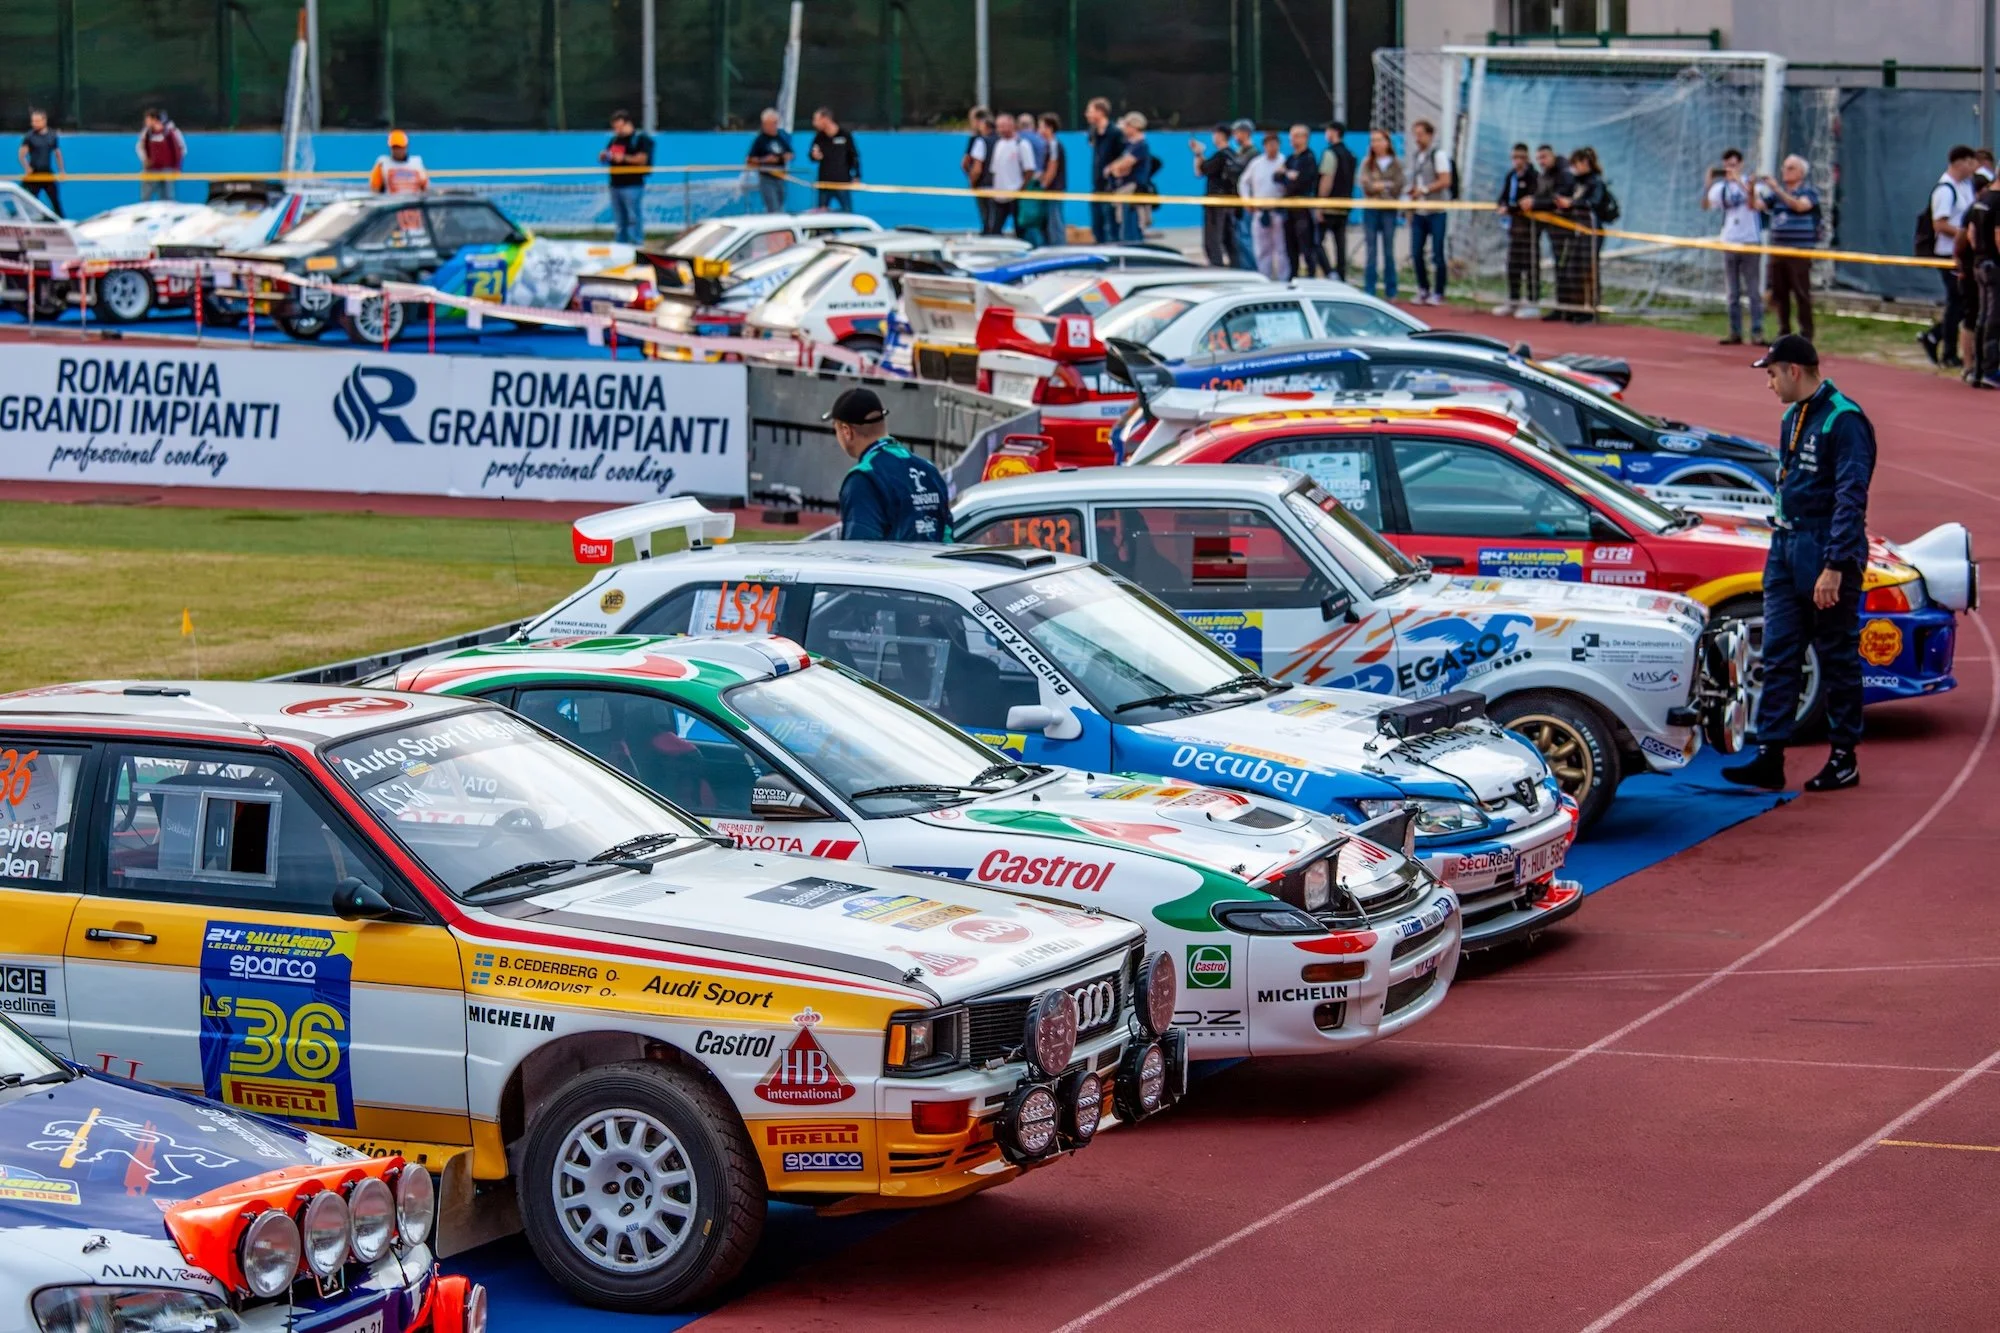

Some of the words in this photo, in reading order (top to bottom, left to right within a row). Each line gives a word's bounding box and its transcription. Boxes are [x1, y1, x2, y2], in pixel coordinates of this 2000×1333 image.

[56, 358, 221, 398] ROMAGNA
[491, 370, 667, 411] ROMAGNA
[0, 395, 124, 434] GRANDI
[130, 398, 280, 440] IMPIANTI
[428, 407, 558, 448] GRANDI
[569, 410, 730, 455] IMPIANTI
[49, 438, 160, 468] professional
[164, 442, 230, 478] cooking
[482, 452, 598, 487] professional
[605, 457, 677, 492] cooking
[580, 543, 607, 557] Rary
[1593, 547, 1633, 560] GT2i
[1498, 566, 1560, 579] sparco
[1590, 569, 1647, 585] PIRELLI
[715, 580, 780, 632] LS34
[985, 607, 1071, 696] rary.racing
[342, 747, 407, 781] Auto
[397, 726, 469, 758] Sport
[1642, 736, 1684, 762] sparco
[1172, 744, 1310, 797] Decubel
[753, 788, 788, 796] TOYOTA
[717, 822, 753, 833] PREPARED
[755, 824, 764, 833] BY
[978, 848, 1116, 892] Castrol
[208, 942, 250, 952] LEGEND
[253, 946, 290, 955] STARS
[1007, 936, 1084, 968] MICHELIN
[229, 954, 317, 979] sparco
[514, 957, 598, 980] CEDERBERG
[1195, 962, 1227, 972] Castrol
[494, 974, 593, 996] S.BLOMQVIST
[642, 974, 700, 999] Audi
[703, 982, 774, 1009] Sport
[1257, 985, 1349, 1003] MICHELIN
[468, 1005, 555, 1032] MICHELIN
[202, 995, 233, 1018] LS
[229, 997, 346, 1080] 36
[695, 1029, 776, 1059] Castrol
[780, 1047, 830, 1086] HB
[231, 1080, 327, 1113] PIRELLI
[767, 1087, 842, 1101] international
[766, 1124, 860, 1146] PIRELLI
[784, 1152, 863, 1171] sparco
[172, 1268, 215, 1285] Racing
